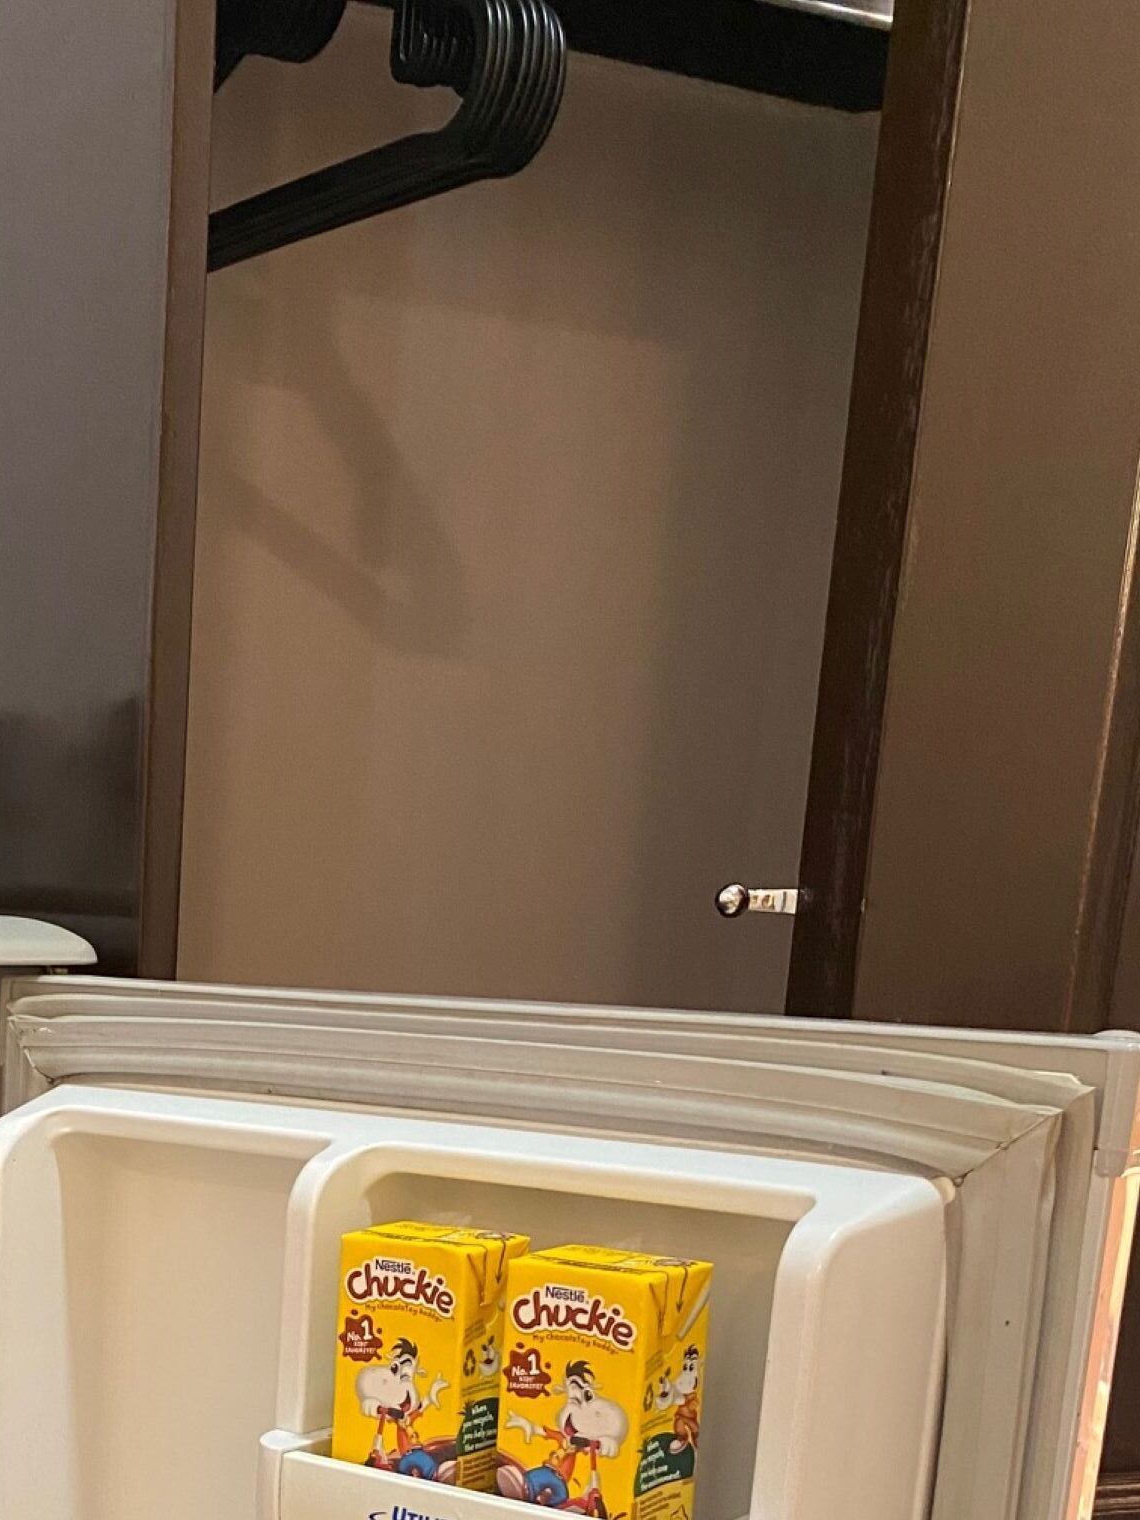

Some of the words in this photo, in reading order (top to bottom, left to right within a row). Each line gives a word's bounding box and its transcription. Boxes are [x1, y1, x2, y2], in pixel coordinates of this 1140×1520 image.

[347, 1262, 454, 1315] Chuckie
[360, 1319, 374, 1340] 1
[512, 1289, 633, 1347] Chuckie
[527, 1353, 541, 1376] 1
